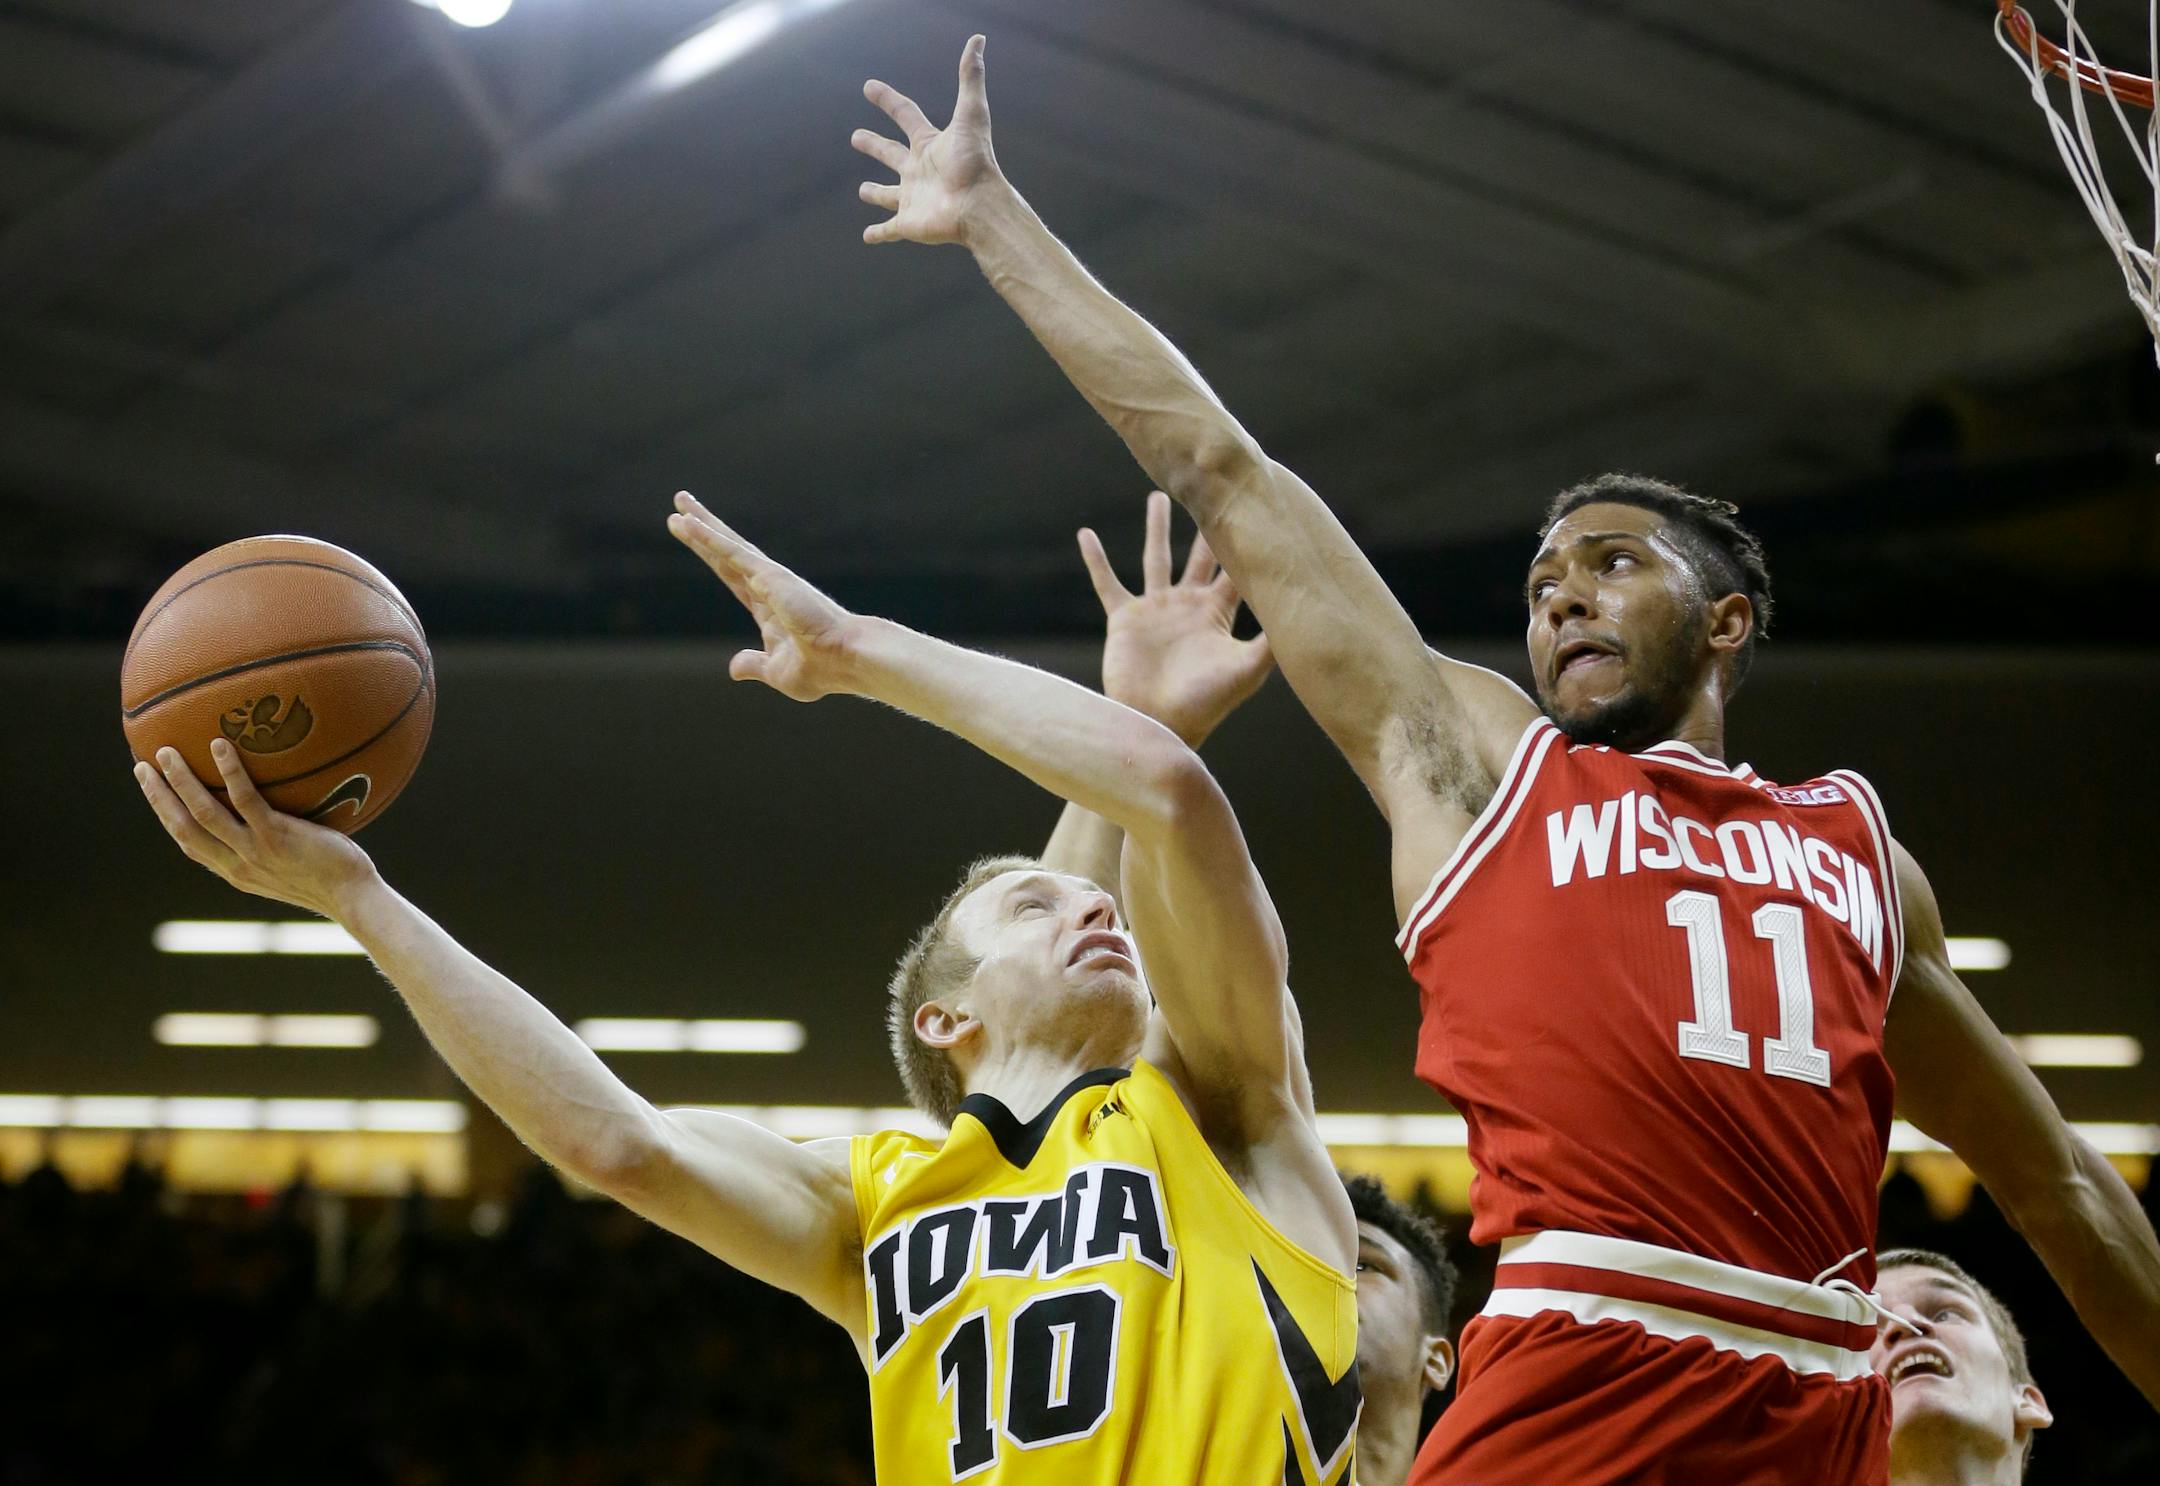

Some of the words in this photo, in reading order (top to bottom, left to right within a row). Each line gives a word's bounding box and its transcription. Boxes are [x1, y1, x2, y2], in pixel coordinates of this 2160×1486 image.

[1547, 790, 1883, 976] WISCONSIN
[1666, 889, 1831, 1088] 11
[864, 1162, 1175, 1375] IOWA
[936, 1283, 1123, 1483] 10
